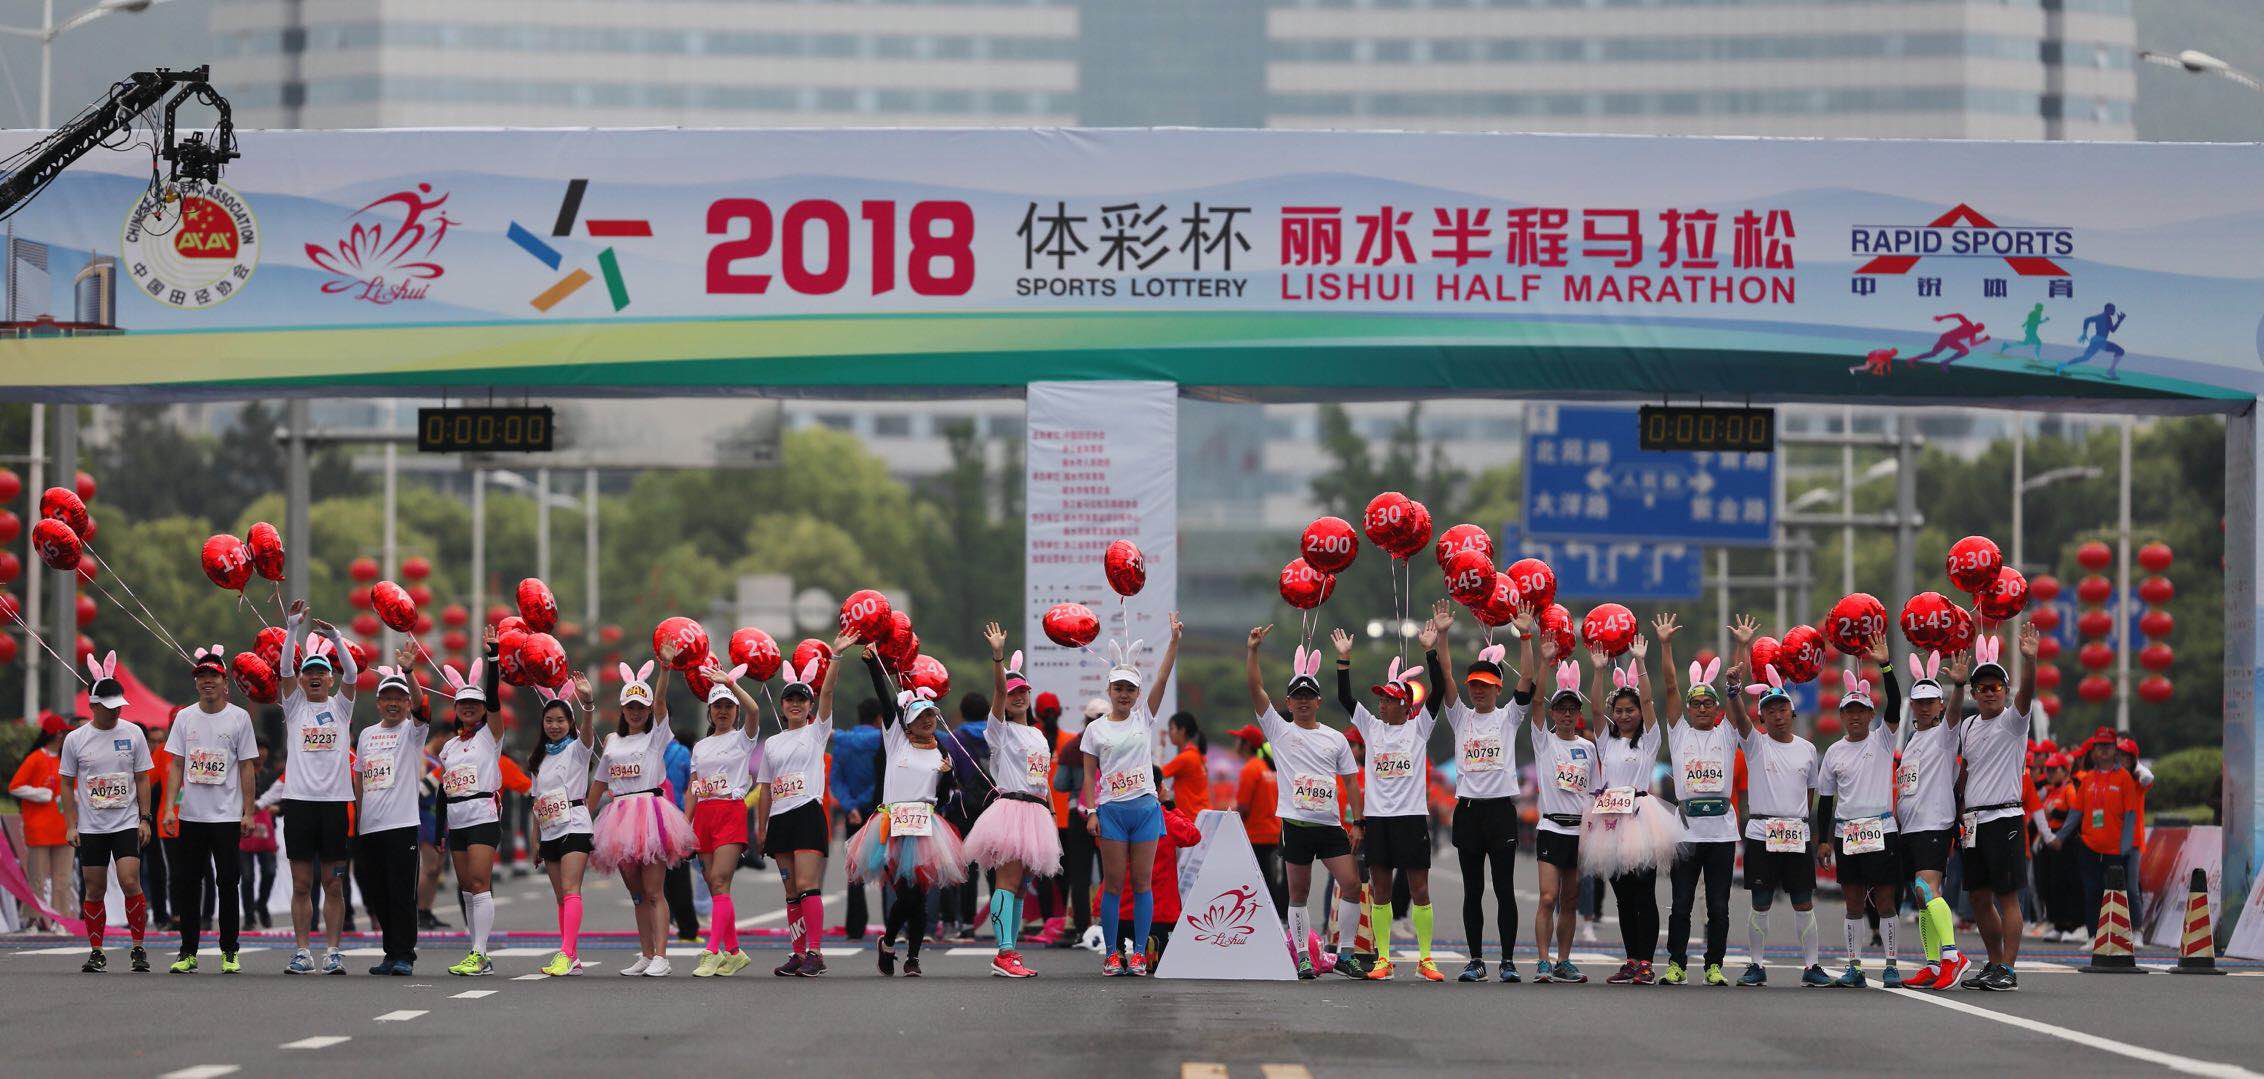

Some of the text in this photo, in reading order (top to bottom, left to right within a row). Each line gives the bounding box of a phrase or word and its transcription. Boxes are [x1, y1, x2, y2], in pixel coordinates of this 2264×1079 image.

[207, 186, 255, 244] ASSOCIATION
[1016, 201, 1252, 271] 体彩杯
[1281, 206, 1796, 270] 丽水半程马拉松
[1852, 230, 2074, 255] RAPID SPORTS
[706, 198, 975, 296] 2018
[1016, 278, 1247, 298] SPORTS LOTTERY
[1281, 273, 1796, 304] LISHUI HALF MARATHON
[426, 415, 545, 444] 0:00:00
[1649, 414, 1766, 443] 0:00:00
[1364, 505, 1401, 530] 1:30
[1307, 534, 1351, 553] 2:00
[1442, 535, 1487, 559] 2:45
[1948, 549, 1991, 574] 2:30
[1445, 568, 1482, 594] 2:45
[840, 598, 876, 630] 3:00
[1907, 610, 1952, 631] 1:45
[1586, 613, 1630, 639] 2:45
[1839, 614, 1884, 636] 2:30
[304, 734, 337, 744] A2237
[1466, 747, 1500, 758] A0797
[191, 761, 225, 772] A1462
[364, 766, 391, 779] A0341
[610, 764, 640, 776] A3440
[1376, 760, 1411, 772] A2746
[1687, 769, 1723, 780] A0494
[91, 786, 127, 797] A0758
[445, 775, 476, 790] A3293
[1111, 773, 1146, 791] A3579
[1296, 786, 1333, 799] A1894
[538, 801, 567, 818] A3695
[1597, 798, 1631, 808] A3449
[893, 814, 928, 825] A3777
[1769, 829, 1802, 840] A1861
[1846, 829, 1881, 843] A1090
